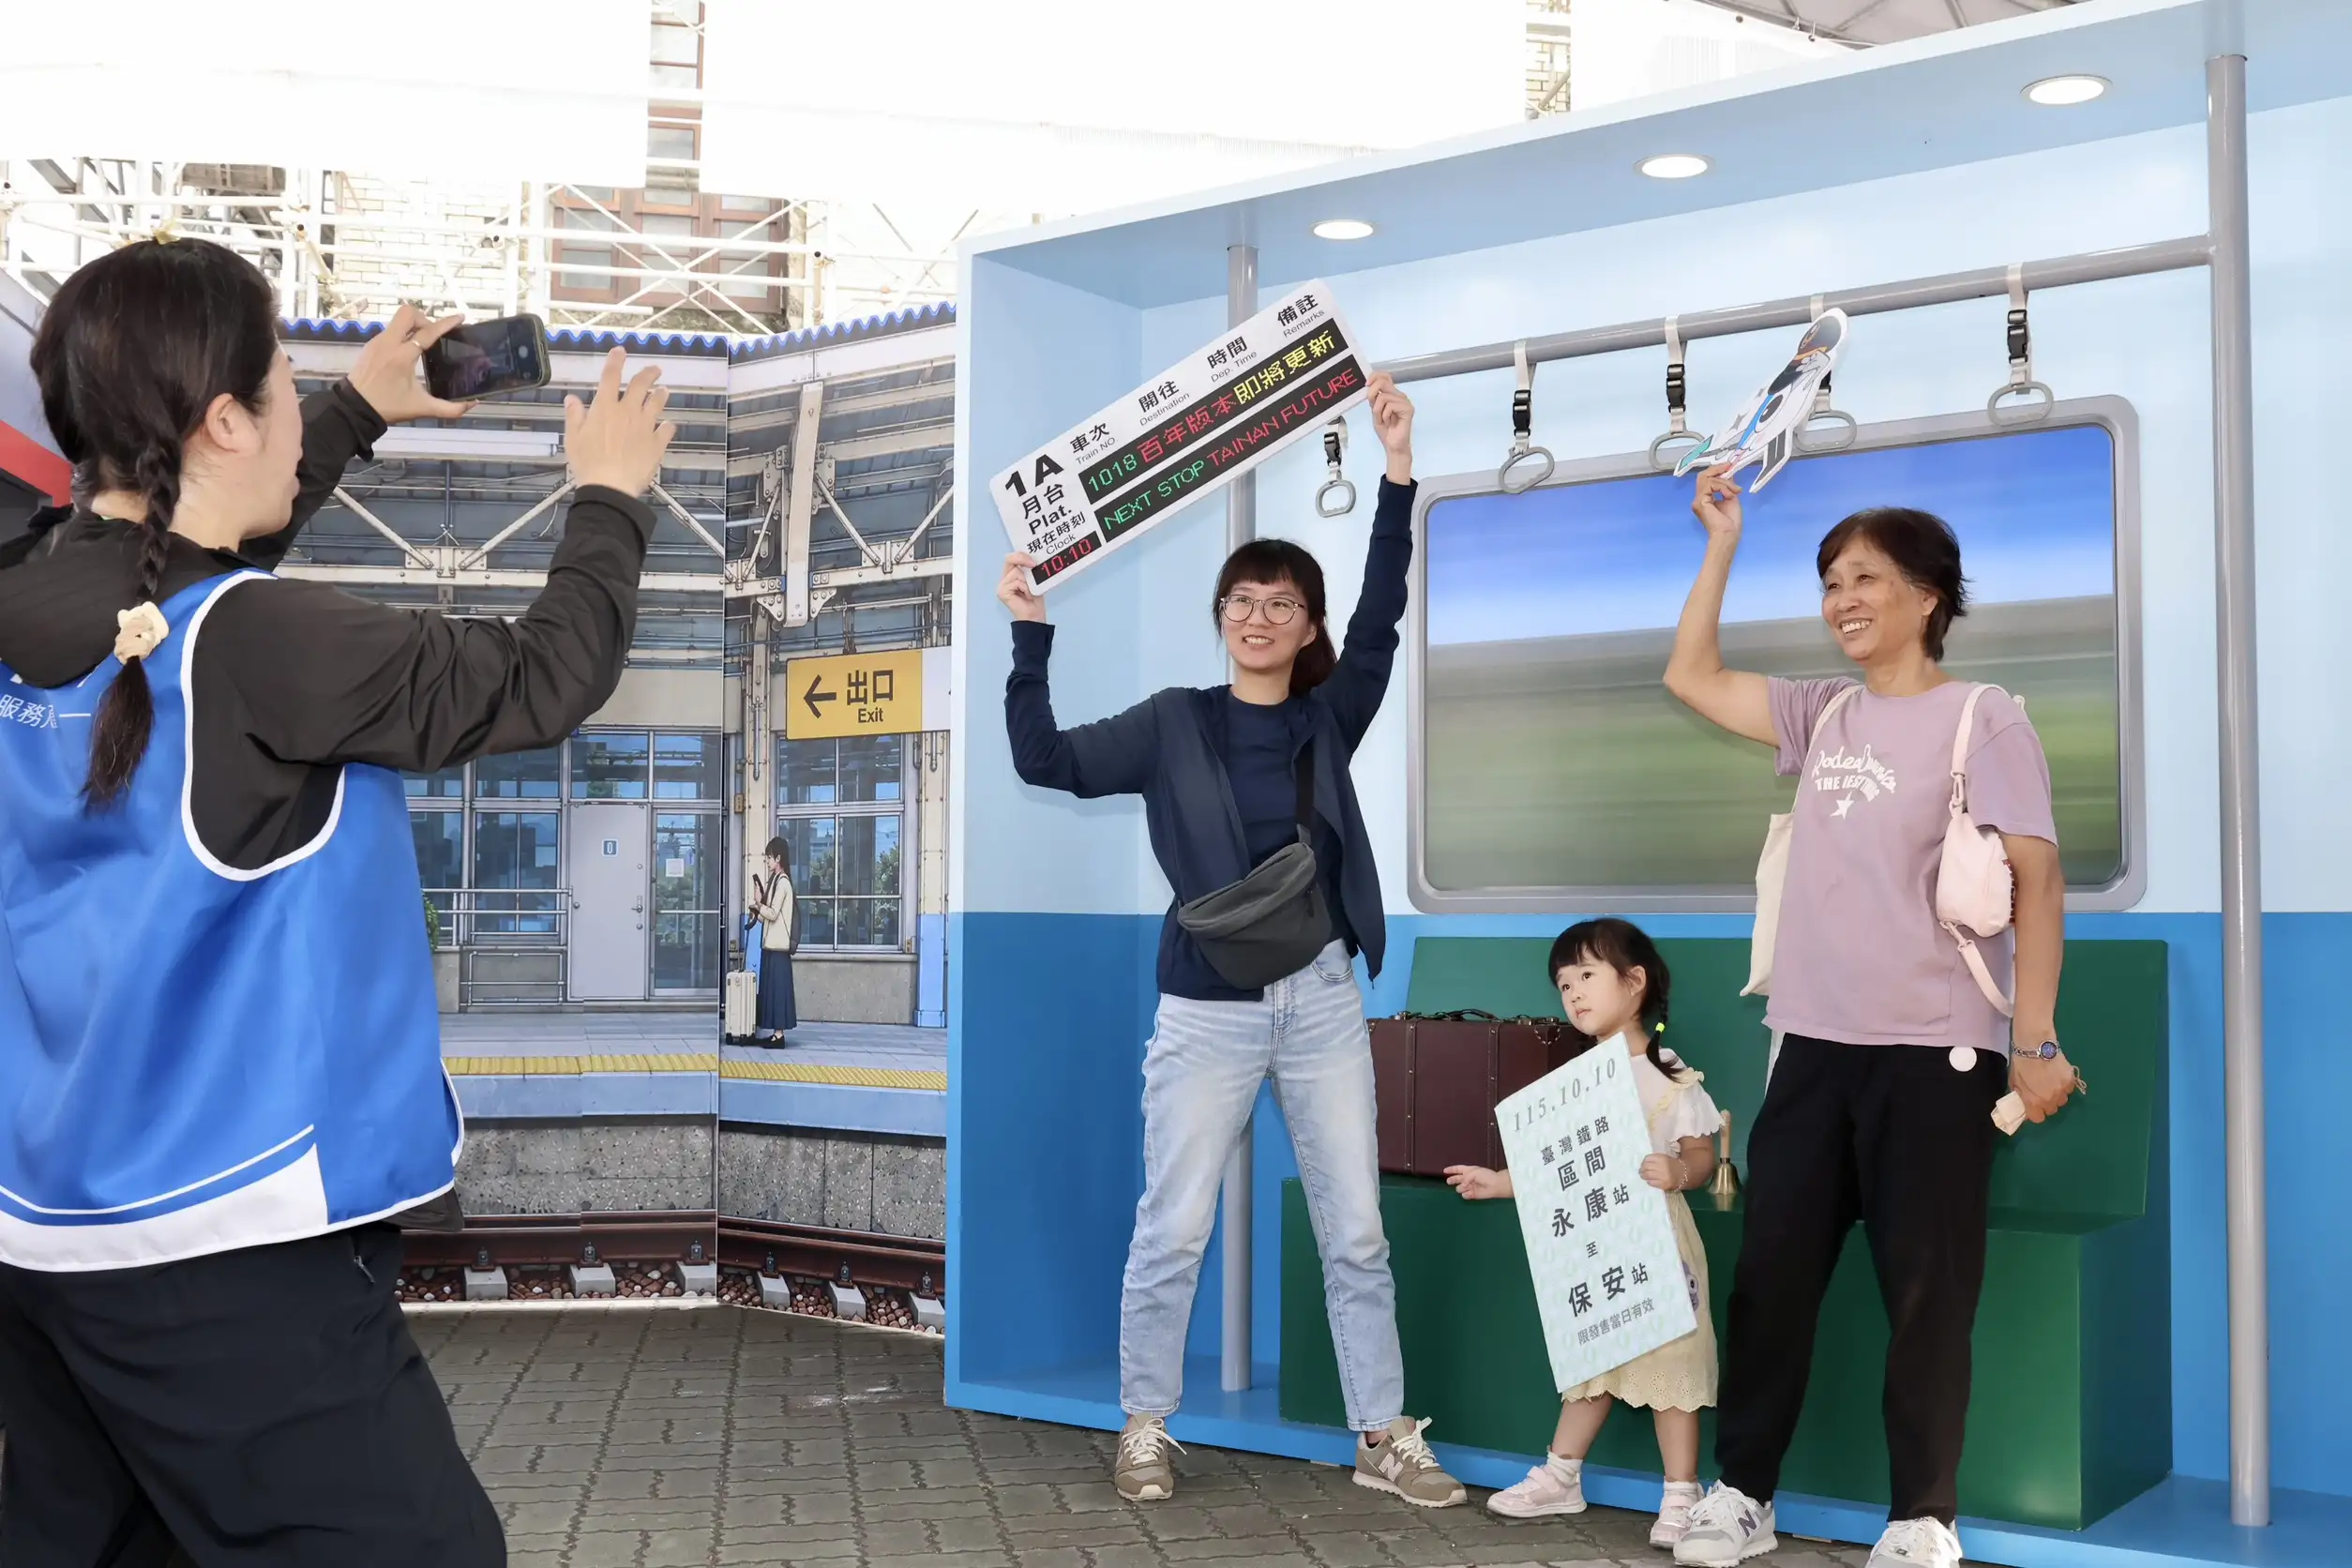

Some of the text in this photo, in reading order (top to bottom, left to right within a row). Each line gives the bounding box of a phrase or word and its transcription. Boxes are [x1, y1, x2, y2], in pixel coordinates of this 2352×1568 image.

[1277, 294, 1319, 326] 備註
[1283, 309, 1325, 339] Remarks
[1207, 336, 1248, 369] 時間
[1211, 351, 1258, 383] Dep. Time
[1138, 380, 1180, 413] 開往
[1139, 392, 1190, 427] Destination
[1070, 423, 1110, 454] 車次
[1105, 368, 1358, 531] NEXT STOP TAINAN FUTURE
[1076, 447, 1098, 466] Train
[1088, 454, 1138, 491] 1018
[1004, 454, 1064, 497] 1A
[1022, 484, 1064, 520] 月台
[1027, 511, 1086, 553] 現在時刻
[1029, 505, 1072, 535] Plat.
[1041, 538, 1092, 577] 10:10
[1046, 534, 1076, 555] Clock
[847, 670, 894, 705] 出口
[858, 707, 883, 723] Exit
[1514, 1058, 1615, 1132] 115.10.10
[1541, 1116, 1609, 1165] 臺灣鐵路
[1558, 1145, 1606, 1191] 區間
[1552, 1184, 1630, 1237] 永康站
[1586, 1241, 1599, 1258] 至
[1568, 1262, 1649, 1318] 保安站
[1577, 1297, 1654, 1346] 限發售當日有效
